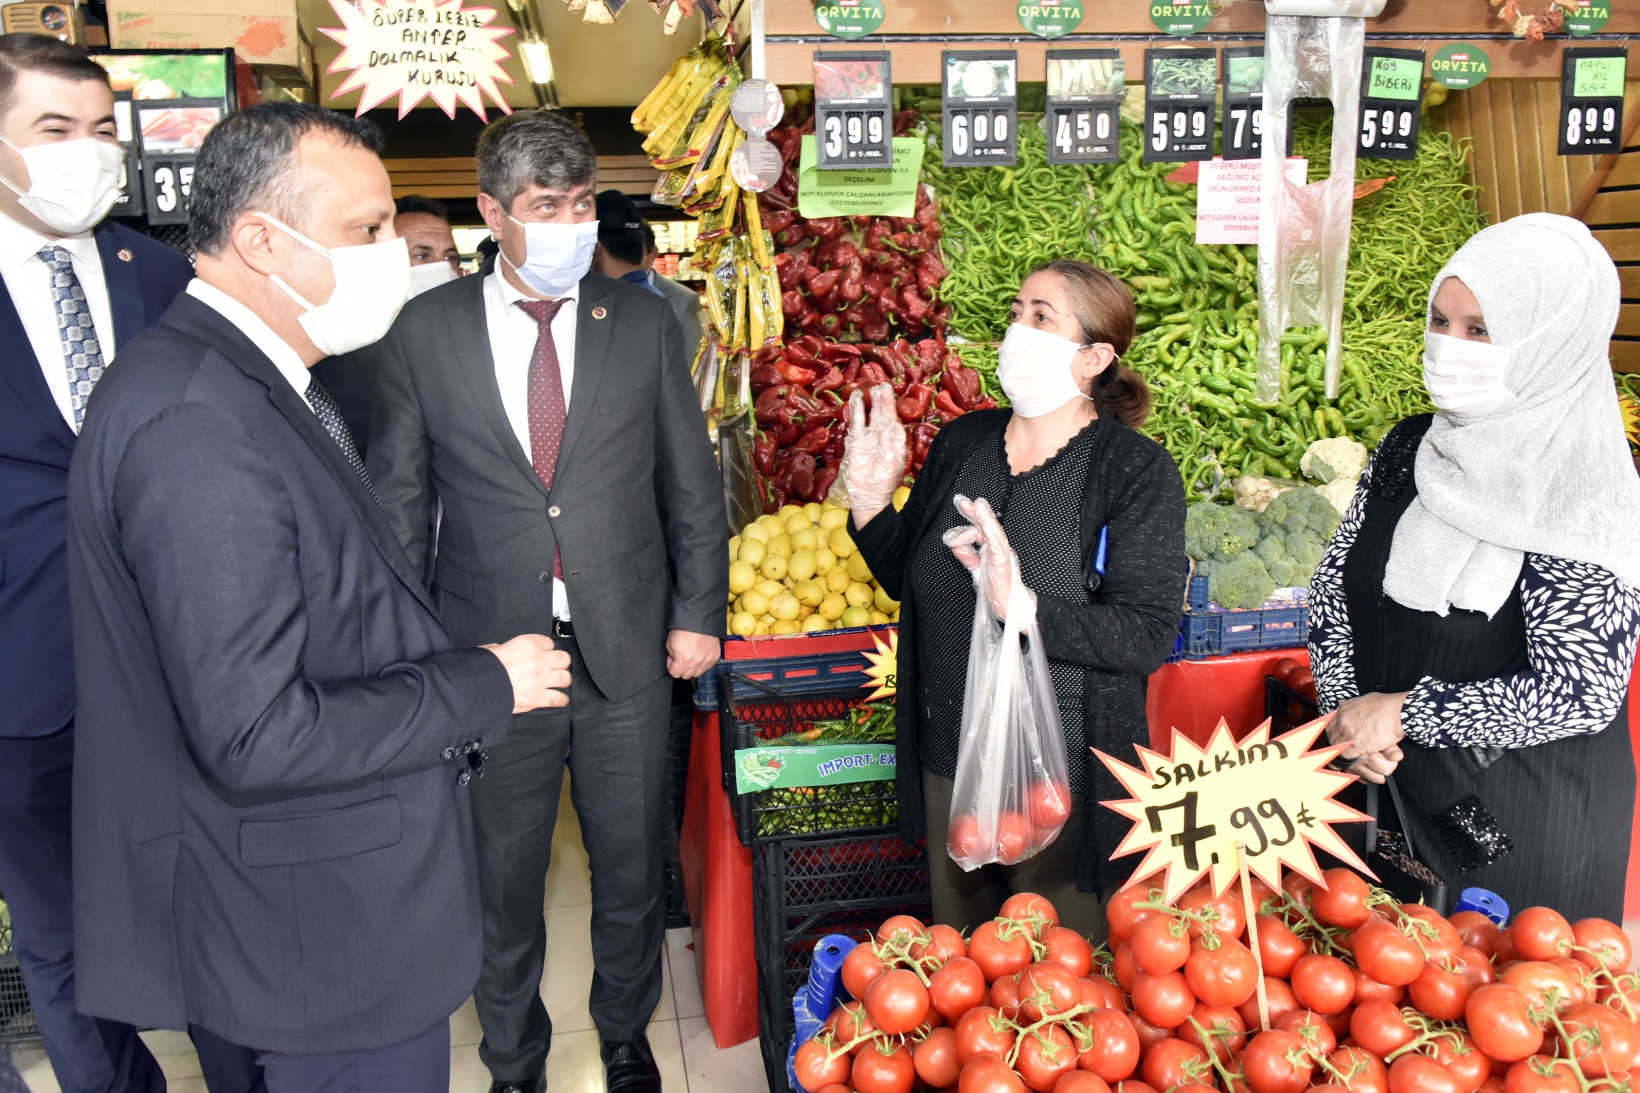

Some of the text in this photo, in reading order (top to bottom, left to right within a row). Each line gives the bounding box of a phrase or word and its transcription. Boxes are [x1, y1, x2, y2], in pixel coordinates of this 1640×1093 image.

[373, 5, 427, 27] SÜPER
[816, 5, 882, 19] ORVITA
[1018, 5, 1082, 19] ORVITA
[1151, 5, 1210, 17] ORVITA
[368, 50, 462, 68] DOLMALIK
[1431, 59, 1487, 73] ORVITA
[1151, 739, 1289, 790] SALKIM
